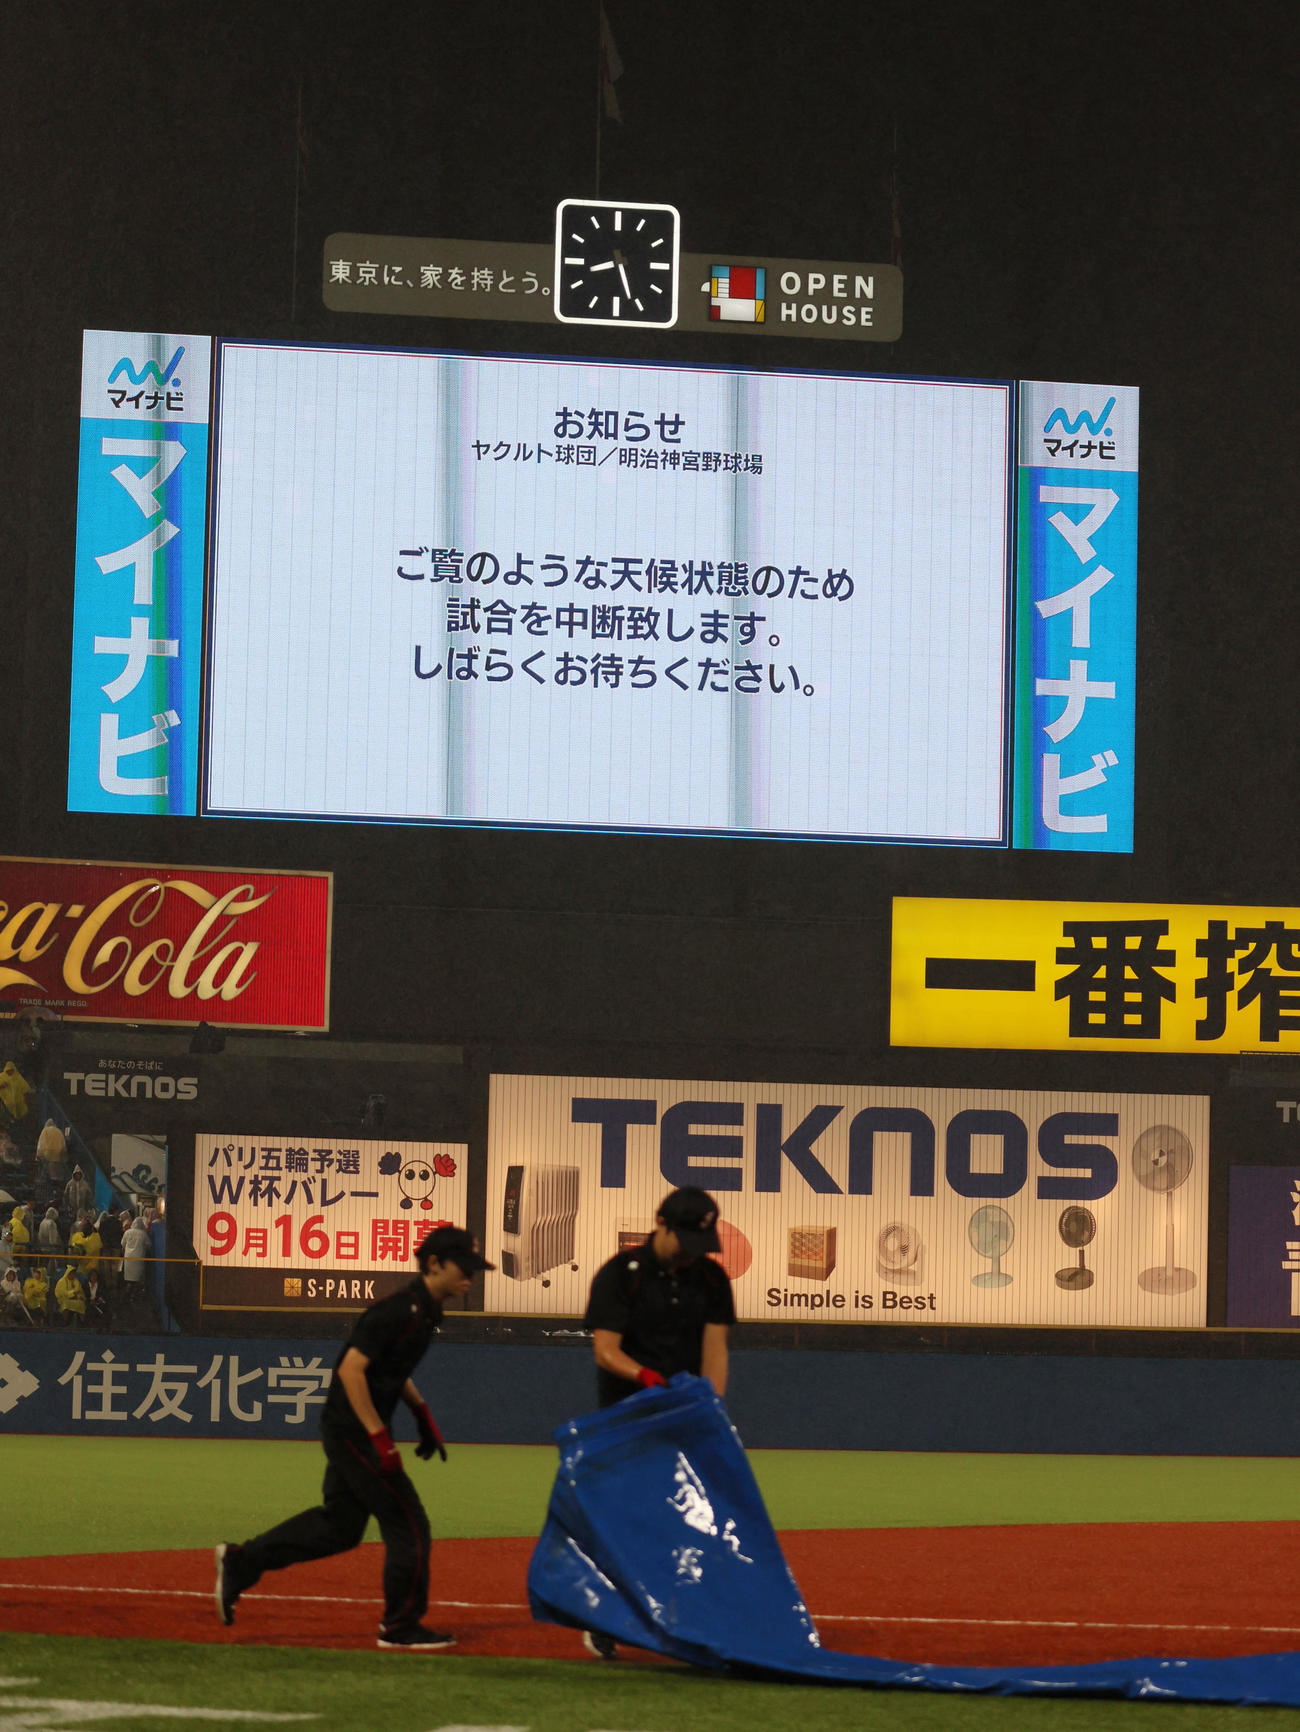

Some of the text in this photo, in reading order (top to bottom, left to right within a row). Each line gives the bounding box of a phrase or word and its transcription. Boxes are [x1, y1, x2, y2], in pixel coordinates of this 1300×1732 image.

[329, 259, 551, 296] 東京に、家を持とう。
[780, 271, 875, 299] OPEN
[780, 302, 874, 327] HOUSE
[107, 389, 184, 412] マイナビ
[553, 406, 685, 443] お知らせ
[1043, 438, 1116, 461] マイナビ
[396, 546, 855, 602] ご覧のような天候状態のため
[94, 436, 187, 796] マイナビ
[446, 597, 781, 648] 試合を中断致します。
[413, 644, 815, 697] しばらくお待ちください。
[1035, 485, 1120, 834] マイナビ
[0, 877, 279, 1001] a-Cola
[98, 1059, 164, 1071] あなたのそばに
[63, 1072, 198, 1100] TEKNOS
[208, 1146, 361, 1175] パリ五輪予選
[571, 1096, 1119, 1201] TEKNOS
[207, 1174, 380, 1208] W杯バレー
[307, 1278, 375, 1299] S-PARK
[766, 1288, 937, 1311] Simple is Best
[57, 1348, 333, 1425] 住友化学
